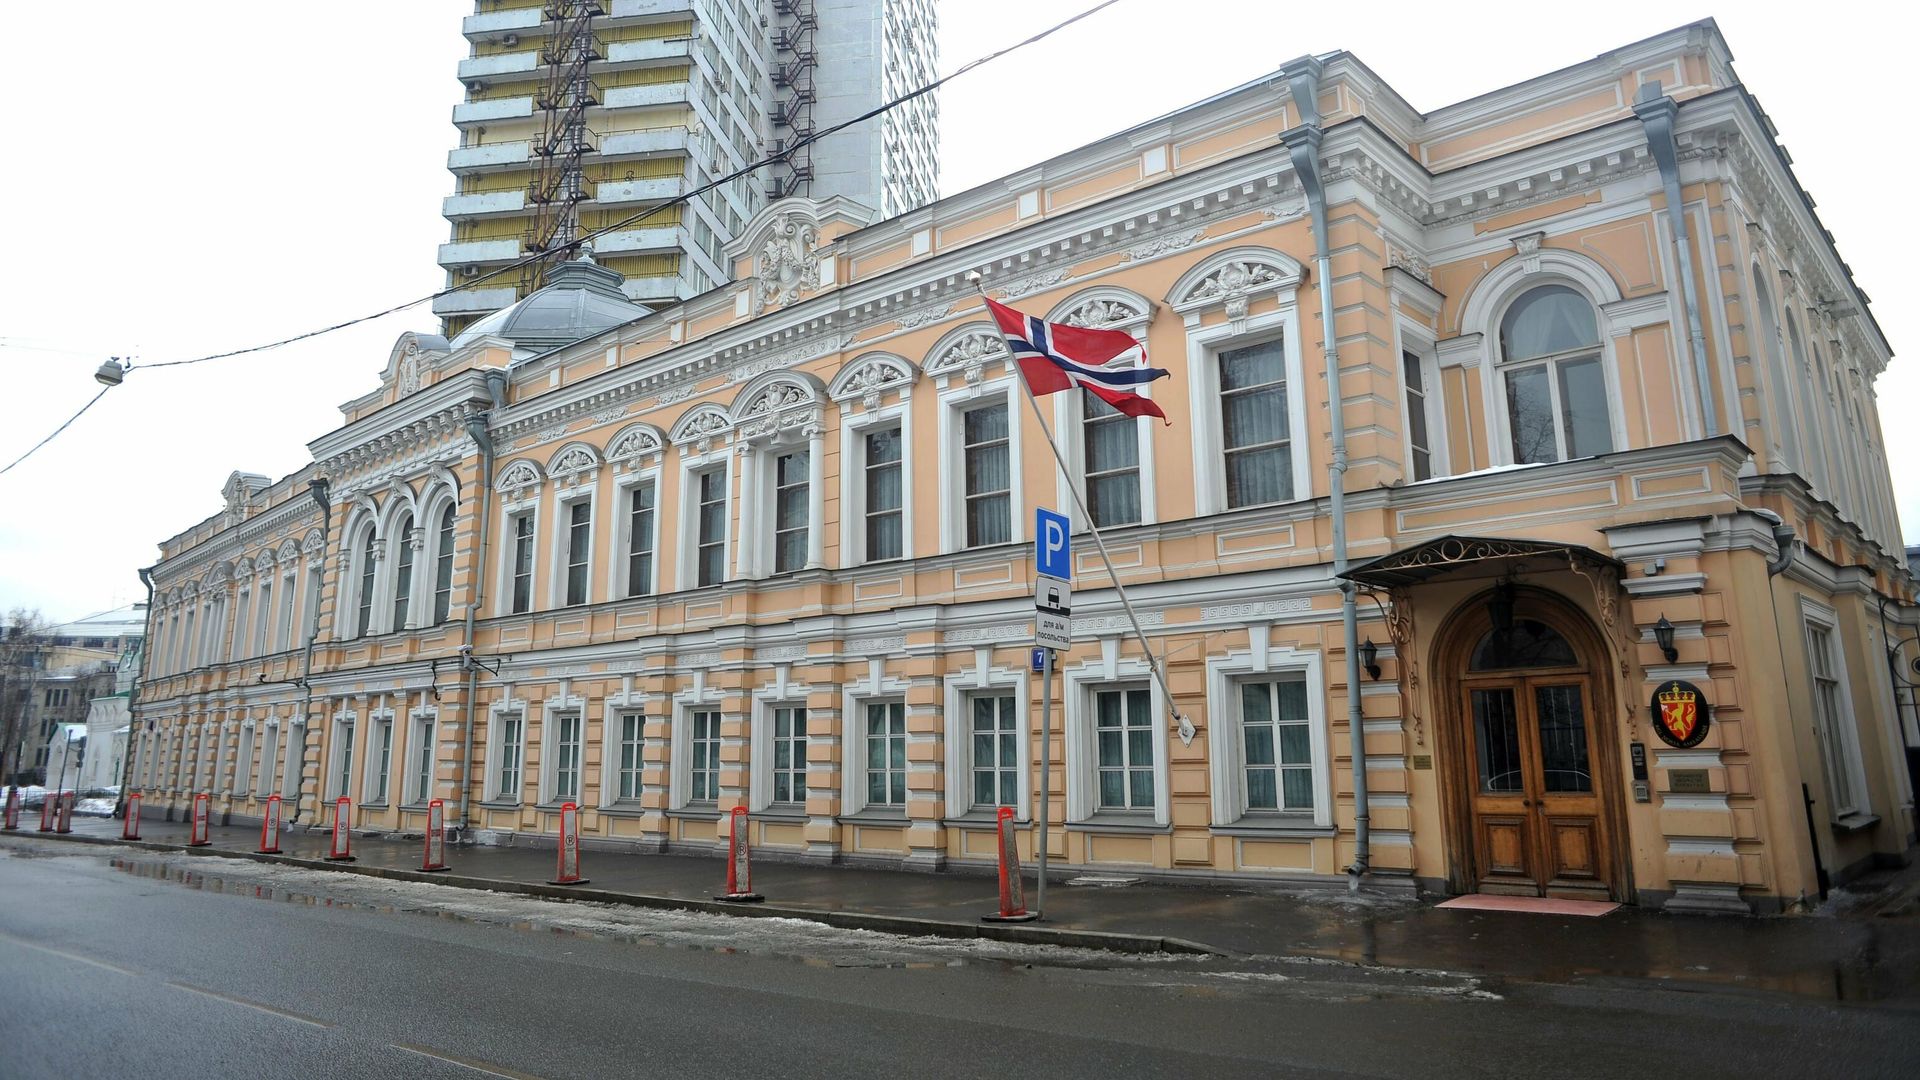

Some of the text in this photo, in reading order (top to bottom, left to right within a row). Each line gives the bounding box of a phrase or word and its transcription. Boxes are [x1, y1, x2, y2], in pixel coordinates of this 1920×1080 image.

[1045, 519, 1064, 567] P
[1043, 620, 1065, 631] для а/м
[1037, 631, 1069, 644] посольства
[1037, 651, 1044, 663] 7
